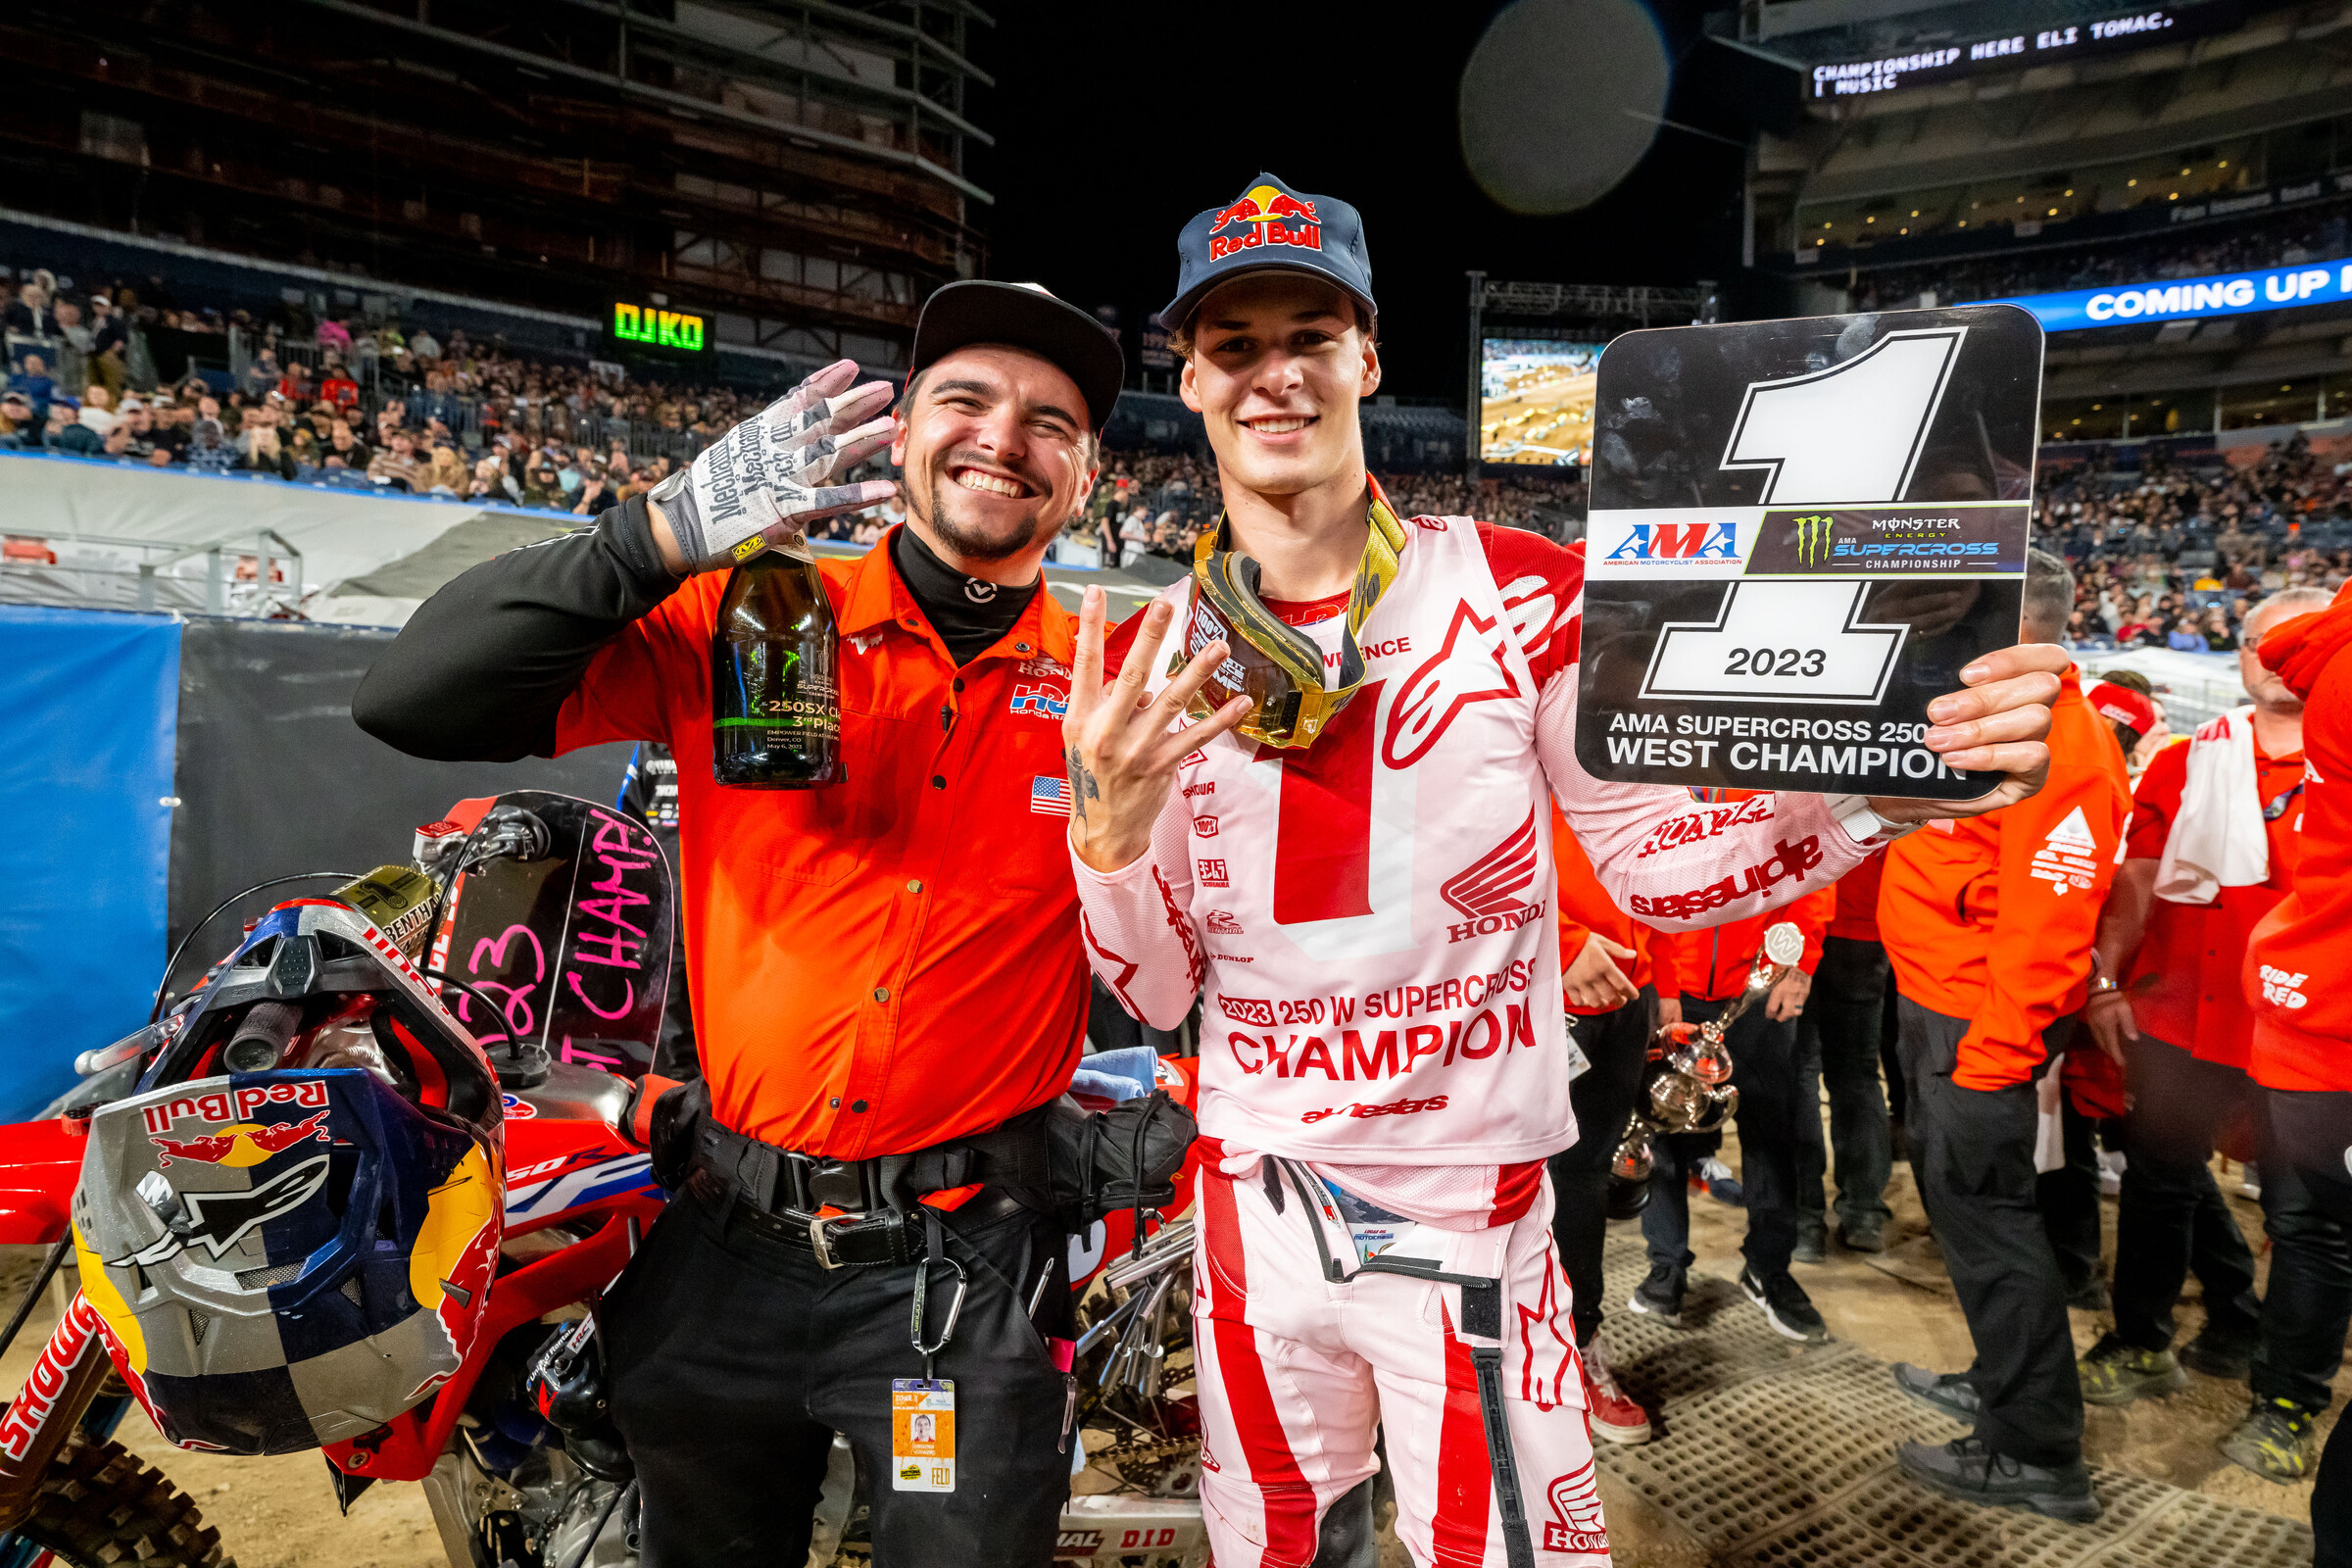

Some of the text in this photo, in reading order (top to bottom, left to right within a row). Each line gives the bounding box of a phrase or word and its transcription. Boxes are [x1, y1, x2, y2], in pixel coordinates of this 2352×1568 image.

[1813, 48, 1961, 82] CHAMPIONSHIP
[1971, 36, 2025, 60] HERE
[2036, 26, 2079, 49] ELI
[1836, 74, 1897, 95] MUSIC
[1209, 221, 1322, 263] Red Bull
[2085, 279, 2255, 320] COMING
[2266, 270, 2330, 302] UP
[614, 302, 704, 351] DJKO
[1872, 516, 1961, 531] MONSTER
[1604, 522, 1742, 560] AMA
[1833, 542, 1999, 557] SUPERCROSS
[1865, 560, 1961, 568] CHAMPIONSHIP
[1725, 648, 1827, 677] 2023
[769, 701, 825, 716] 250SX
[793, 715, 812, 727] 3rd
[1009, 709, 1050, 720] Honda
[1608, 712, 1669, 734] AMA
[1676, 714, 1872, 741] SUPERCROSS
[1606, 736, 1719, 768] WEST
[1183, 781, 1215, 799] SHOWA
[1217, 954, 1254, 963] DUNLOP
[2259, 964, 2309, 989] RIDE
[2262, 981, 2308, 1008] RED
[1219, 1000, 1273, 1026] 2023
[1278, 998, 1325, 1025] 250
[1331, 996, 1355, 1026] W
[1227, 998, 1537, 1081] CHAMPION
[140, 1079, 330, 1135] Red Bull
[931, 1467, 951, 1485] FELD
